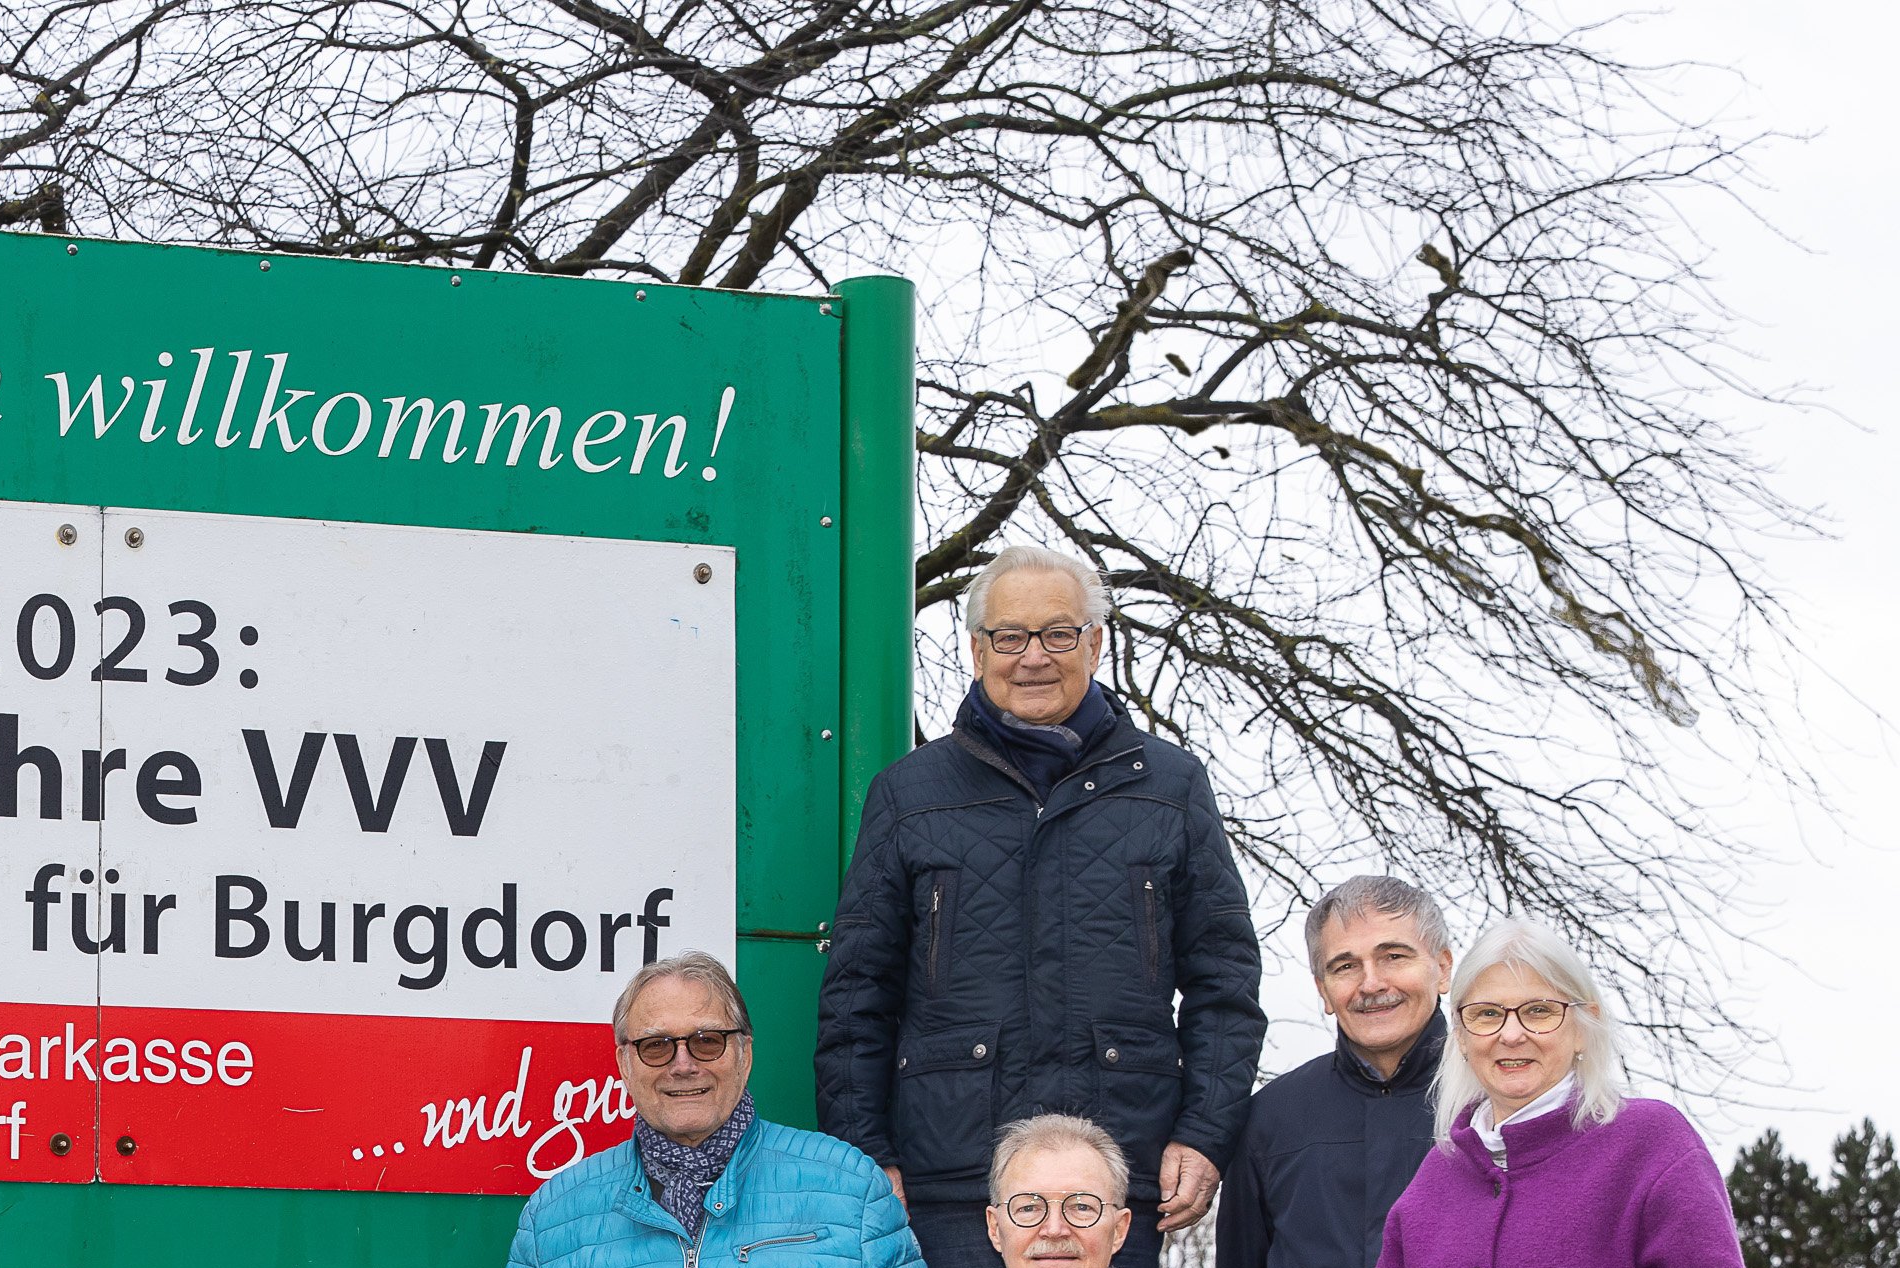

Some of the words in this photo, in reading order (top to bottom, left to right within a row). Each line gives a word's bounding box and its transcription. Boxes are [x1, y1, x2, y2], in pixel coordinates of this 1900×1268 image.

[44, 347, 736, 482] willkommen!
[241, 728, 508, 837] VVV
[25, 863, 177, 955] für
[214, 874, 674, 991] Burgdorf
